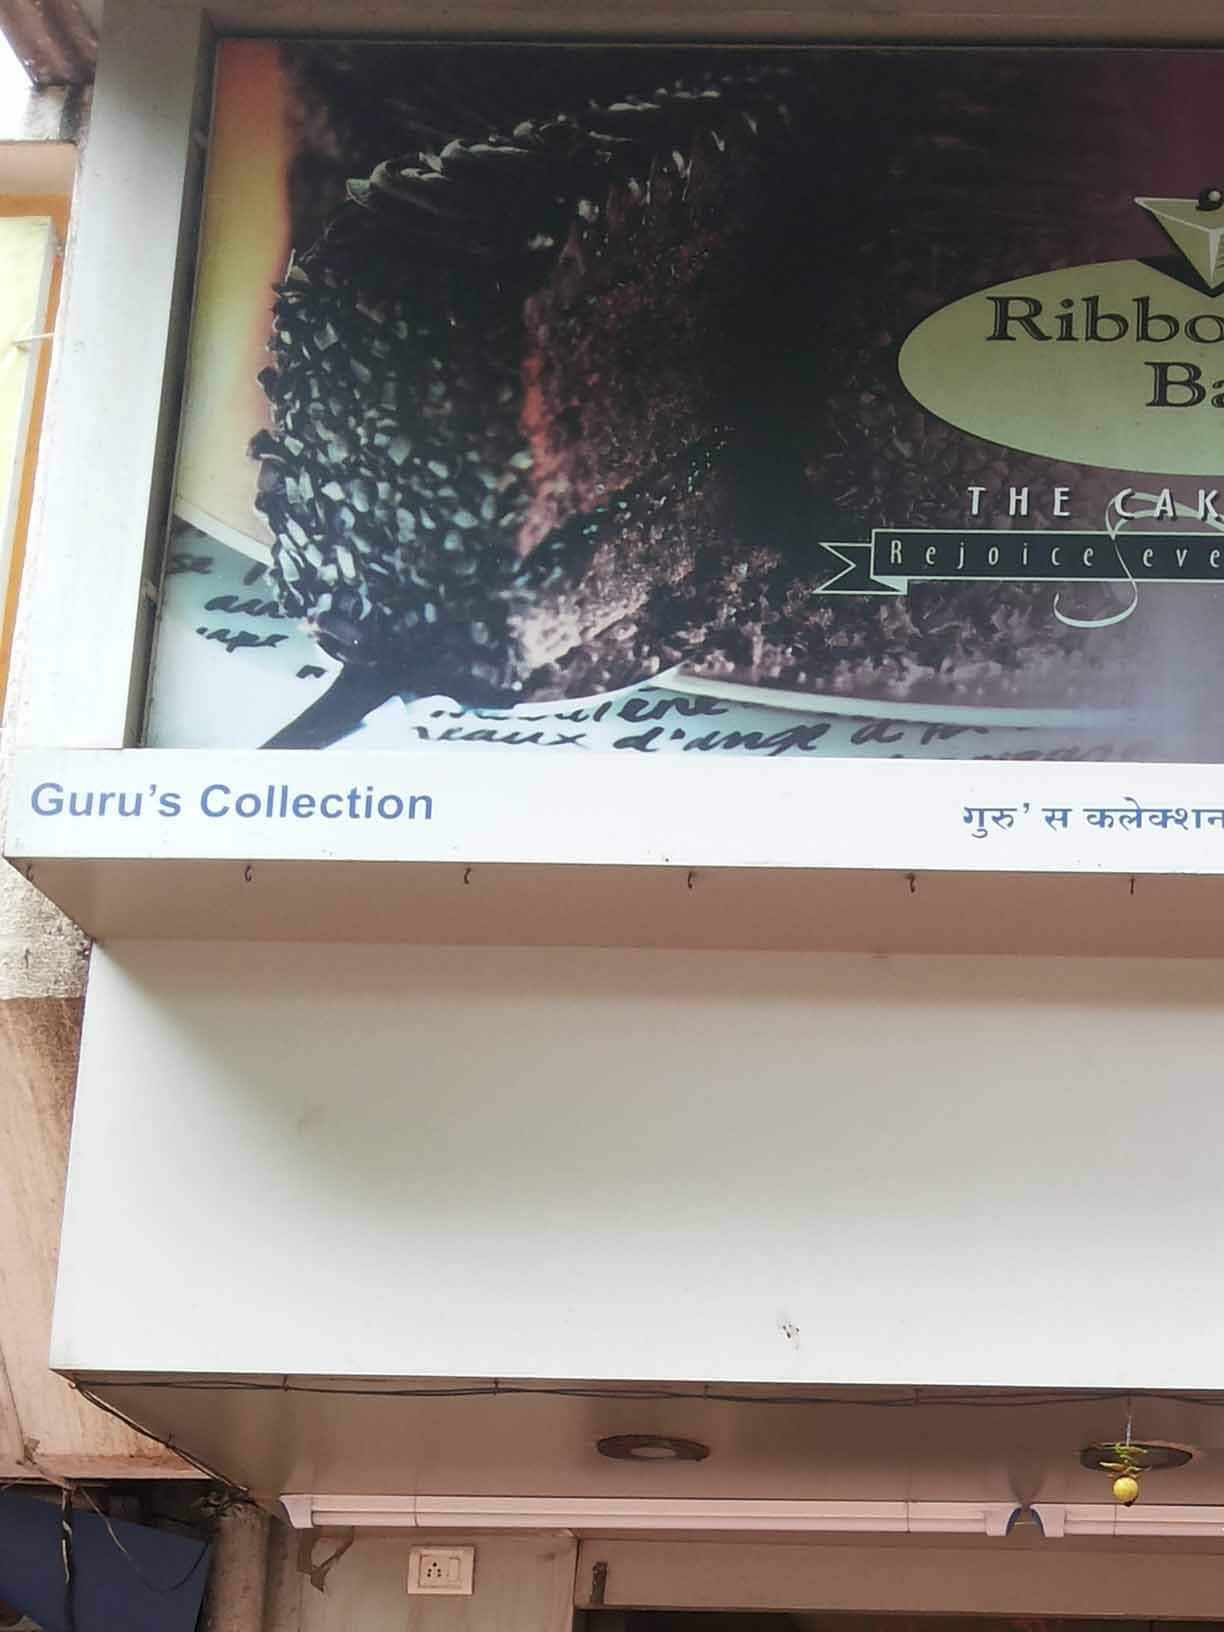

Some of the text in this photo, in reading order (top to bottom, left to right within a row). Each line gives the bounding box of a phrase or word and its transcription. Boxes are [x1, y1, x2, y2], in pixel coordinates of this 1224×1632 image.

[967, 486, 1071, 517] THE
[889, 540, 1095, 571] Rejoice
[30, 781, 434, 820] Guru's Collection
